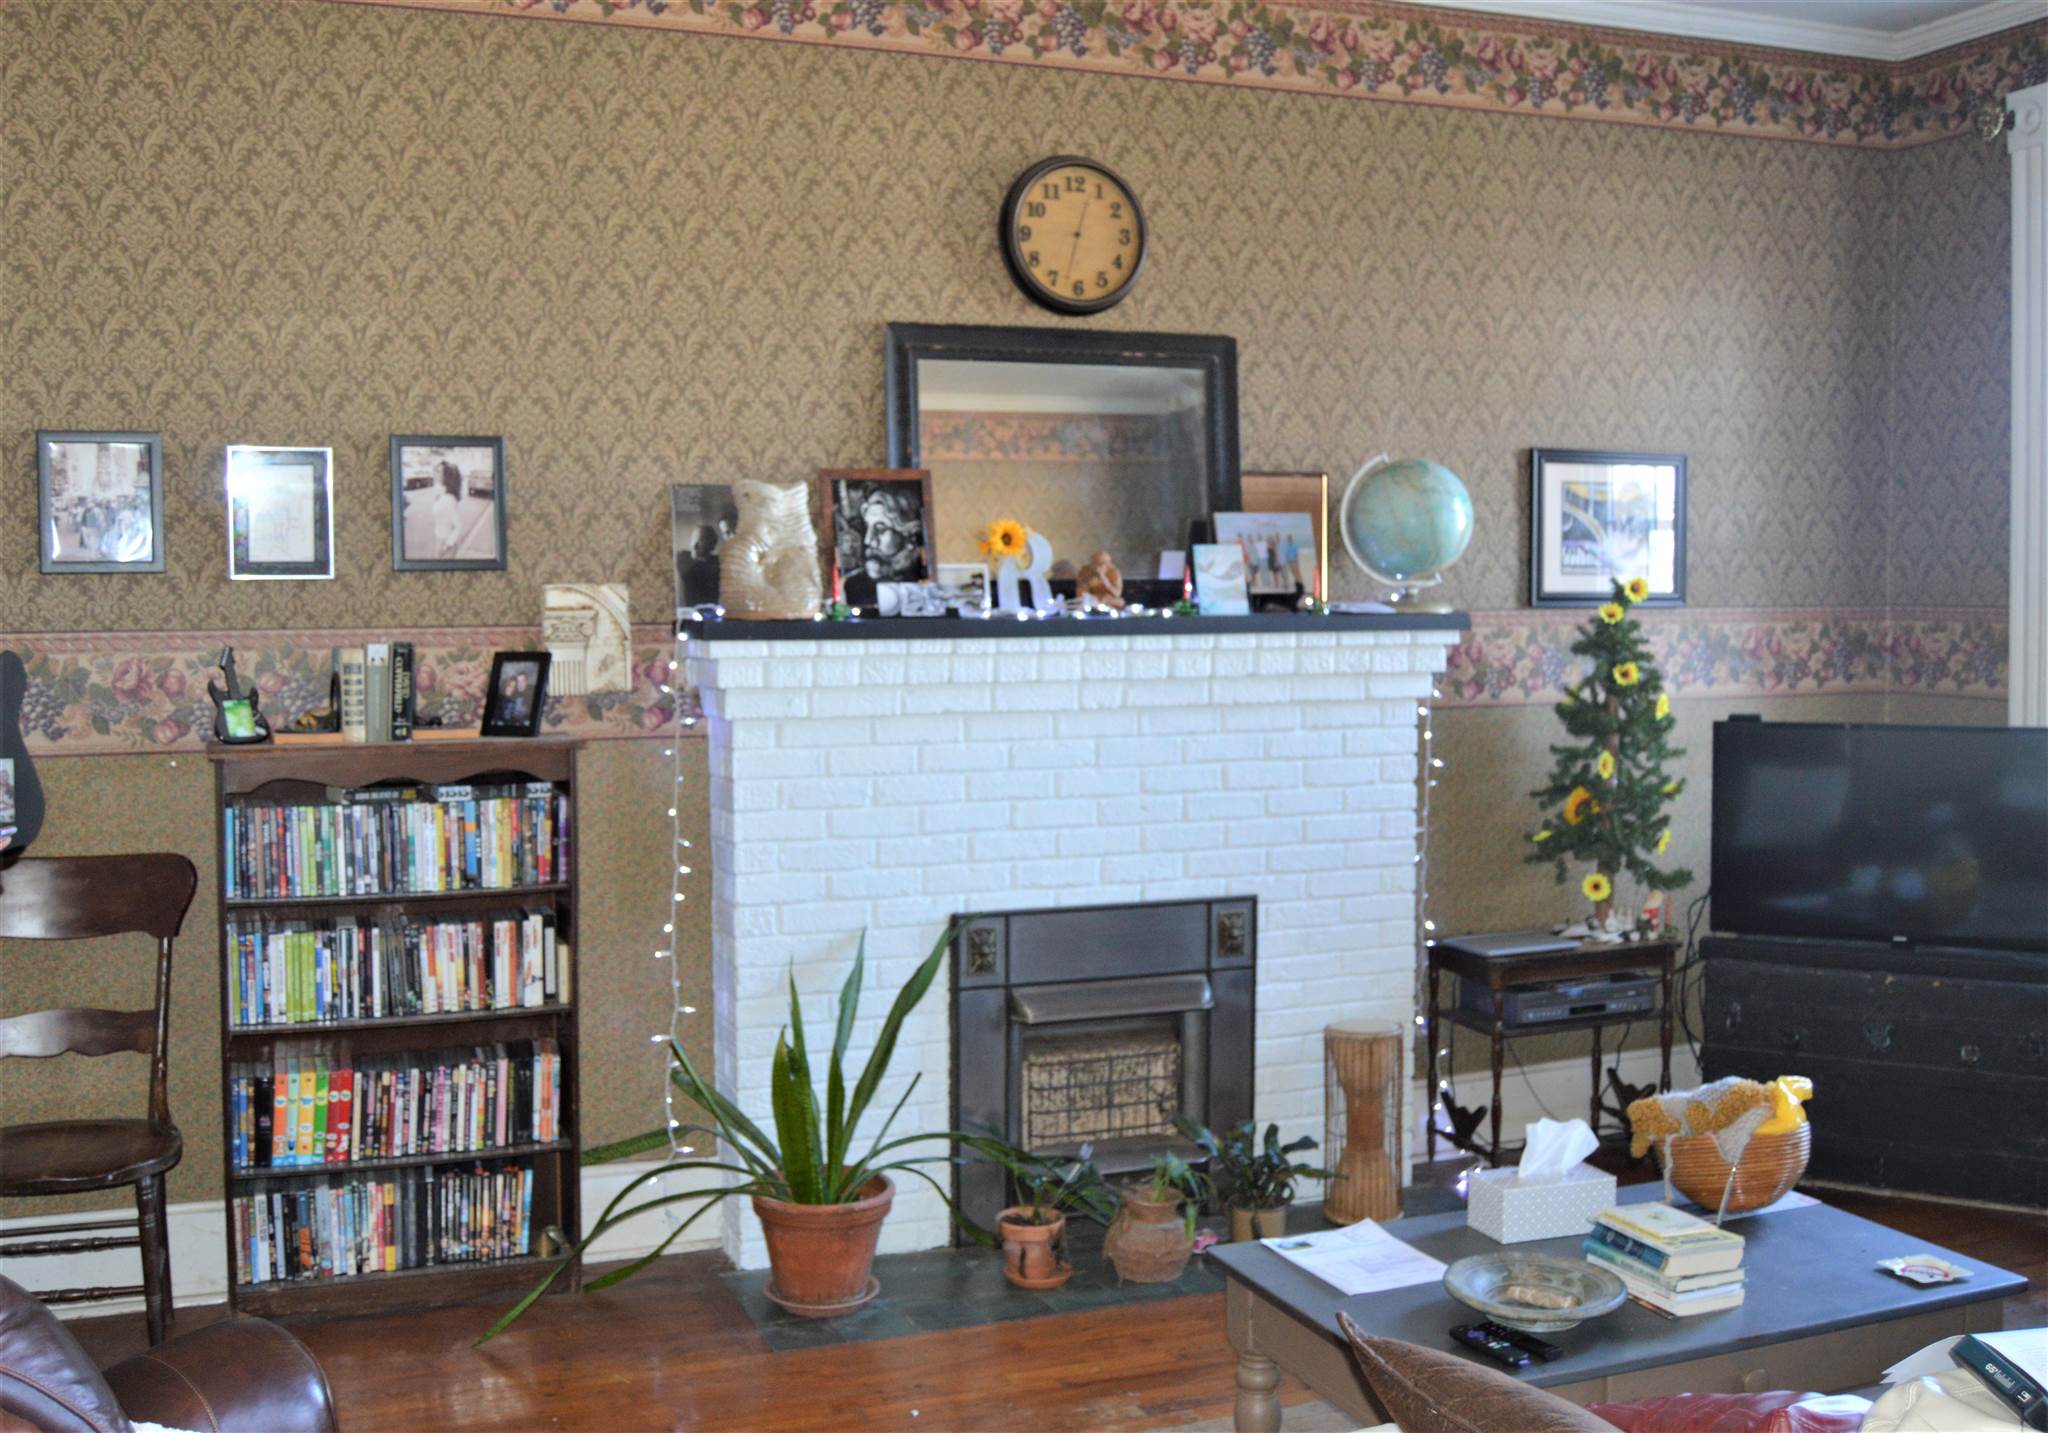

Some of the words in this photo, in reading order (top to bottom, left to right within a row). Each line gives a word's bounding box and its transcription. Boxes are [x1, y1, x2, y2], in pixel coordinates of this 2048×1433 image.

[1043, 184, 1060, 200] 11
[1064, 176, 1085, 192] 12
[1095, 183, 1103, 199] 1
[1026, 202, 1046, 217] 10
[1110, 202, 1121, 218] 2
[1019, 225, 1031, 242] 9
[1118, 229, 1130, 245] 3
[1029, 251, 1040, 267] 8
[1112, 254, 1123, 269] 4
[1047, 270, 1059, 286] 7
[1095, 271, 1108, 288] 5
[1072, 280, 1084, 296] 6
